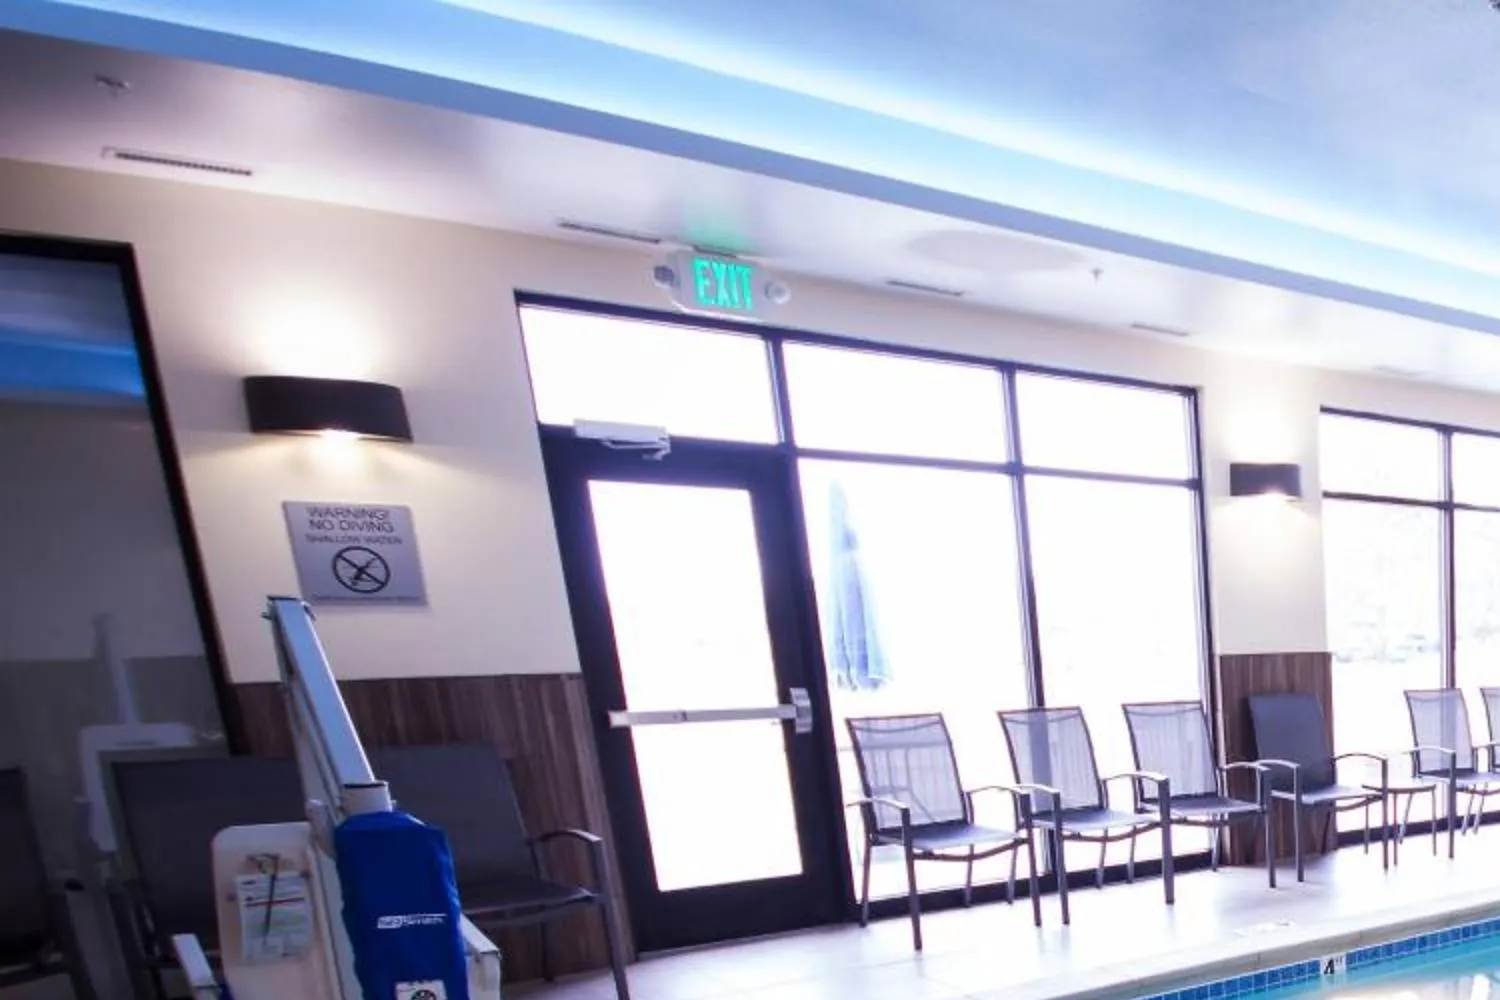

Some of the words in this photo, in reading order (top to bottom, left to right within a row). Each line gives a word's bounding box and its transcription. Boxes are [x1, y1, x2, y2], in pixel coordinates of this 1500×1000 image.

[694, 257, 753, 311] EXIT
[308, 519, 335, 531] NO
[339, 520, 394, 533] DIVING
